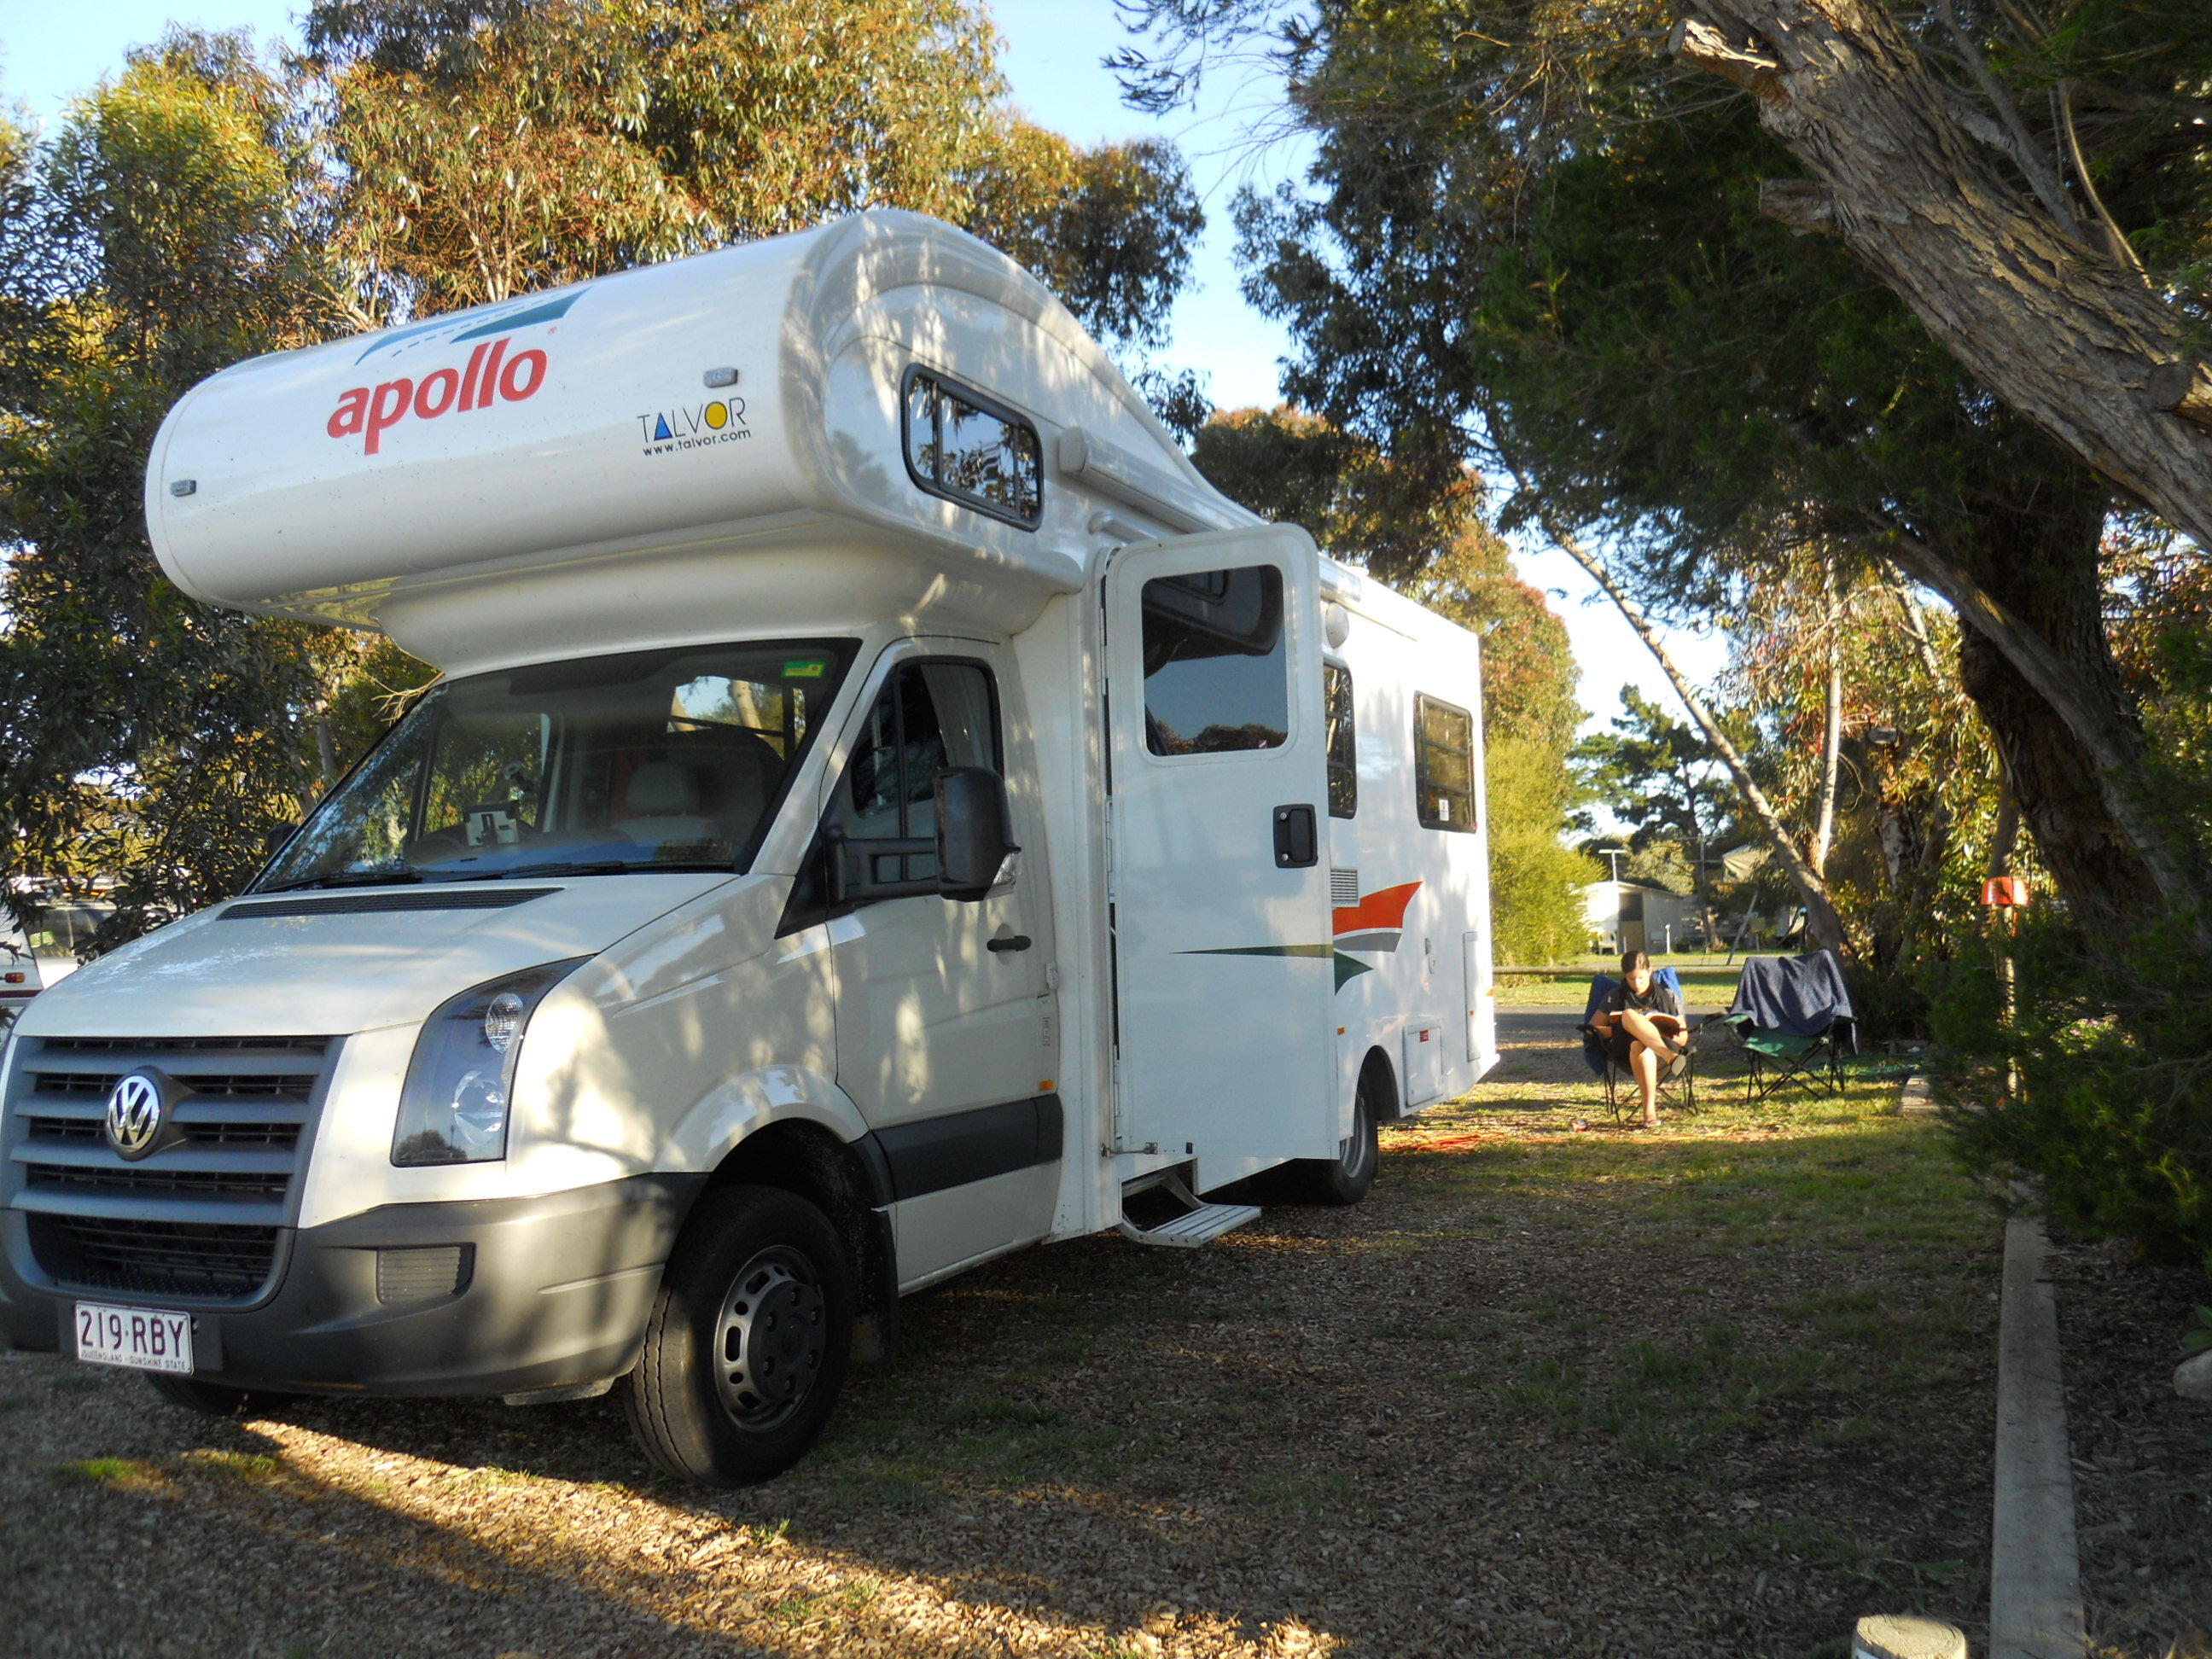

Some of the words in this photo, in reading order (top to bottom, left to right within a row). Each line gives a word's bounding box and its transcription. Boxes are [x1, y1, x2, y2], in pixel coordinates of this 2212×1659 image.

[327, 337, 548, 456] apollo
[637, 397, 747, 443] TALVOR
[643, 429, 752, 457] www.talvor.com
[130, 1355, 162, 1367] SUNSHINE
[165, 1359, 186, 1371] STATE
